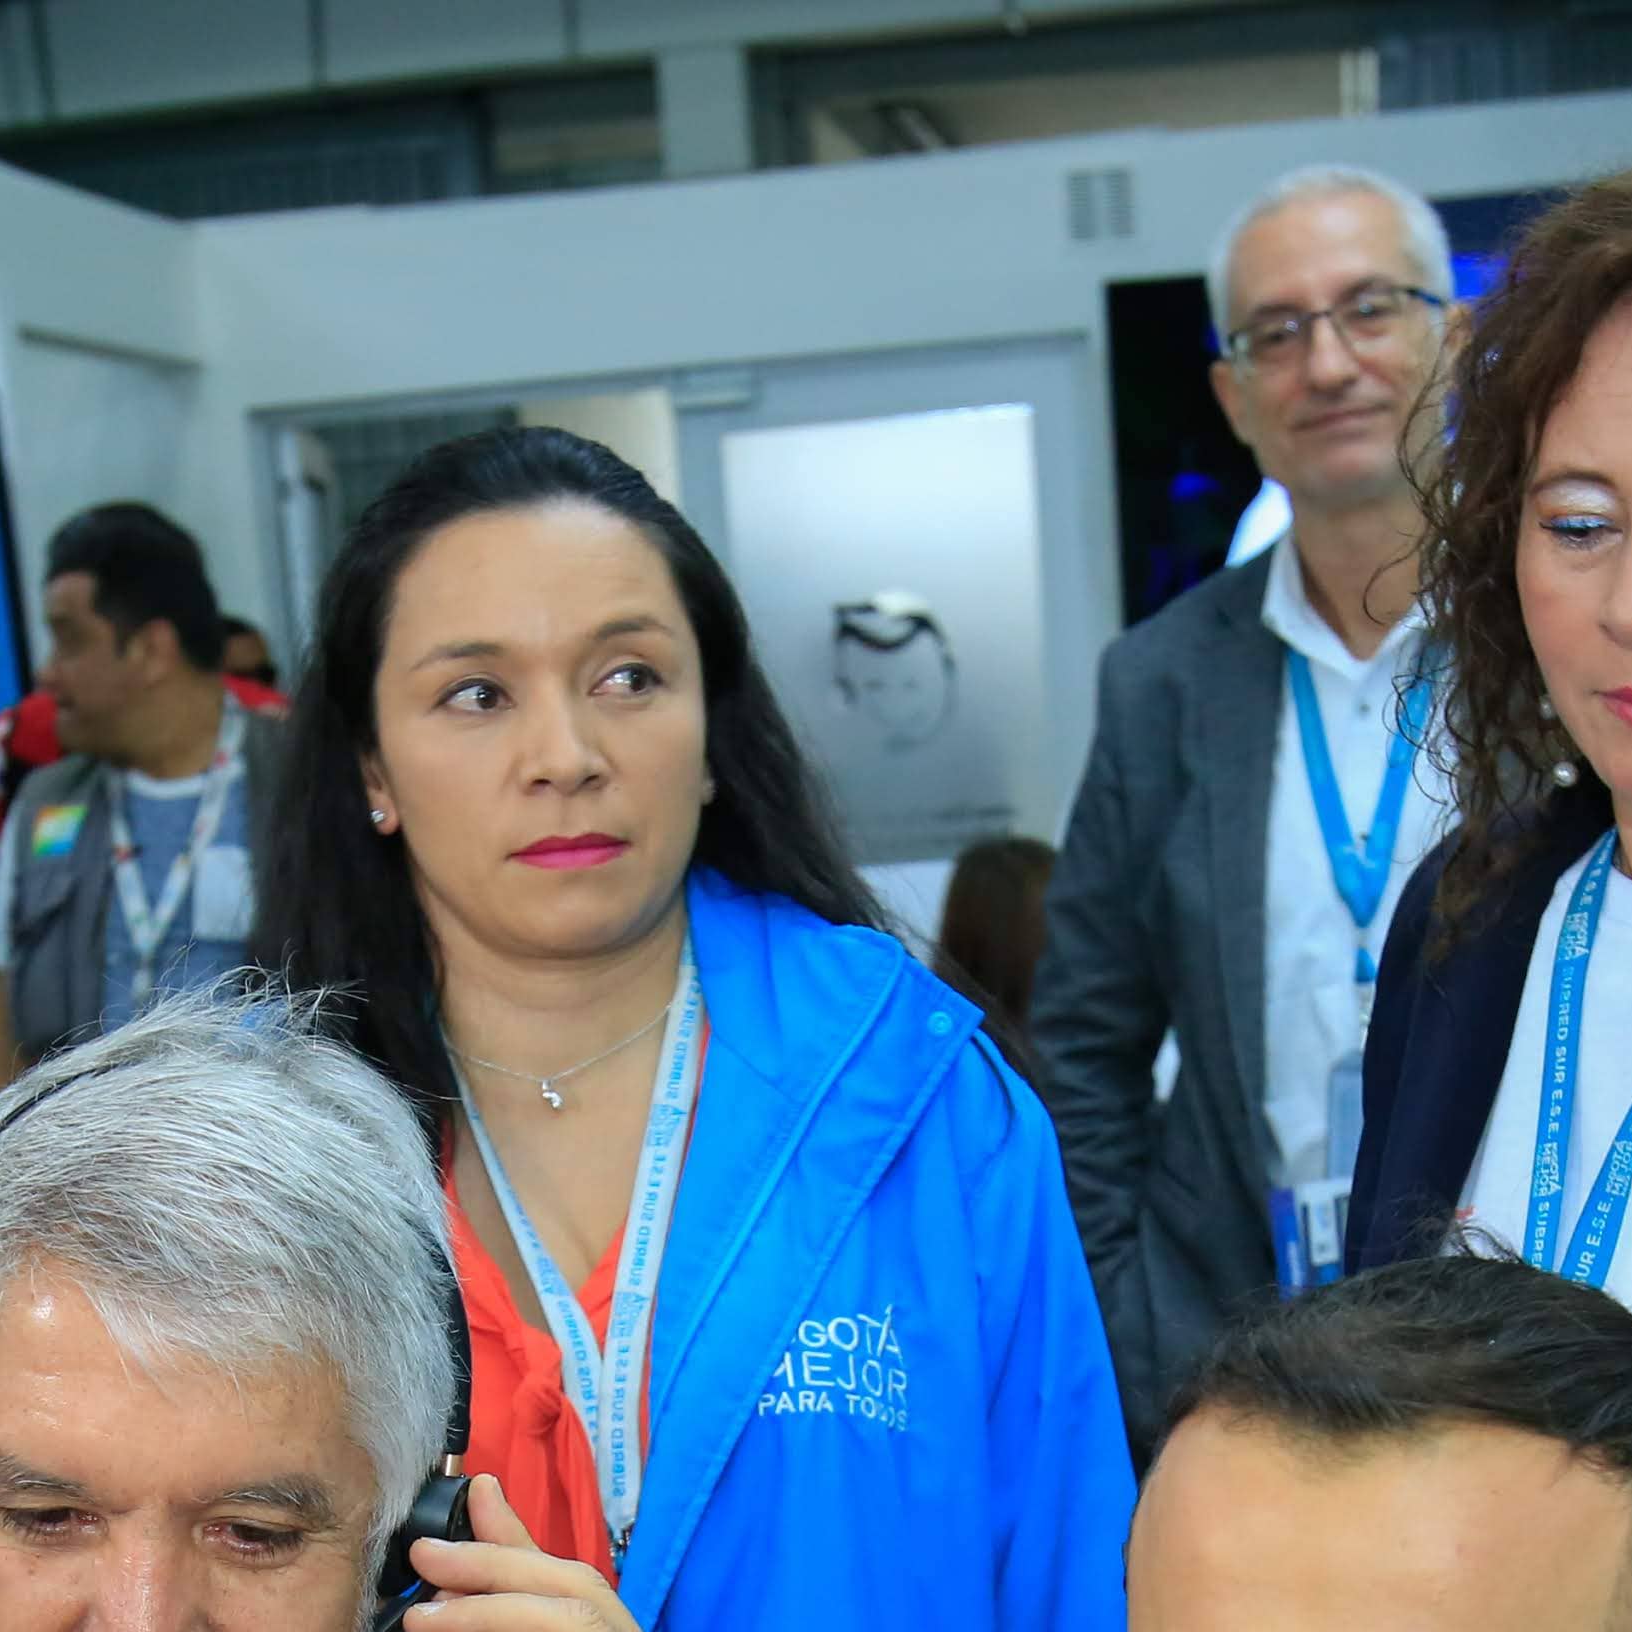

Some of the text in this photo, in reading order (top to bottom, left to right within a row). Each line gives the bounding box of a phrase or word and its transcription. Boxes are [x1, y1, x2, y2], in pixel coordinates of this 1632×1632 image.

[1554, 1046, 1566, 1083] SUR
[1586, 1195, 1615, 1247] E.S.E.
[793, 1303, 905, 1368] GOTÁ
[758, 1389, 835, 1417] PARA
